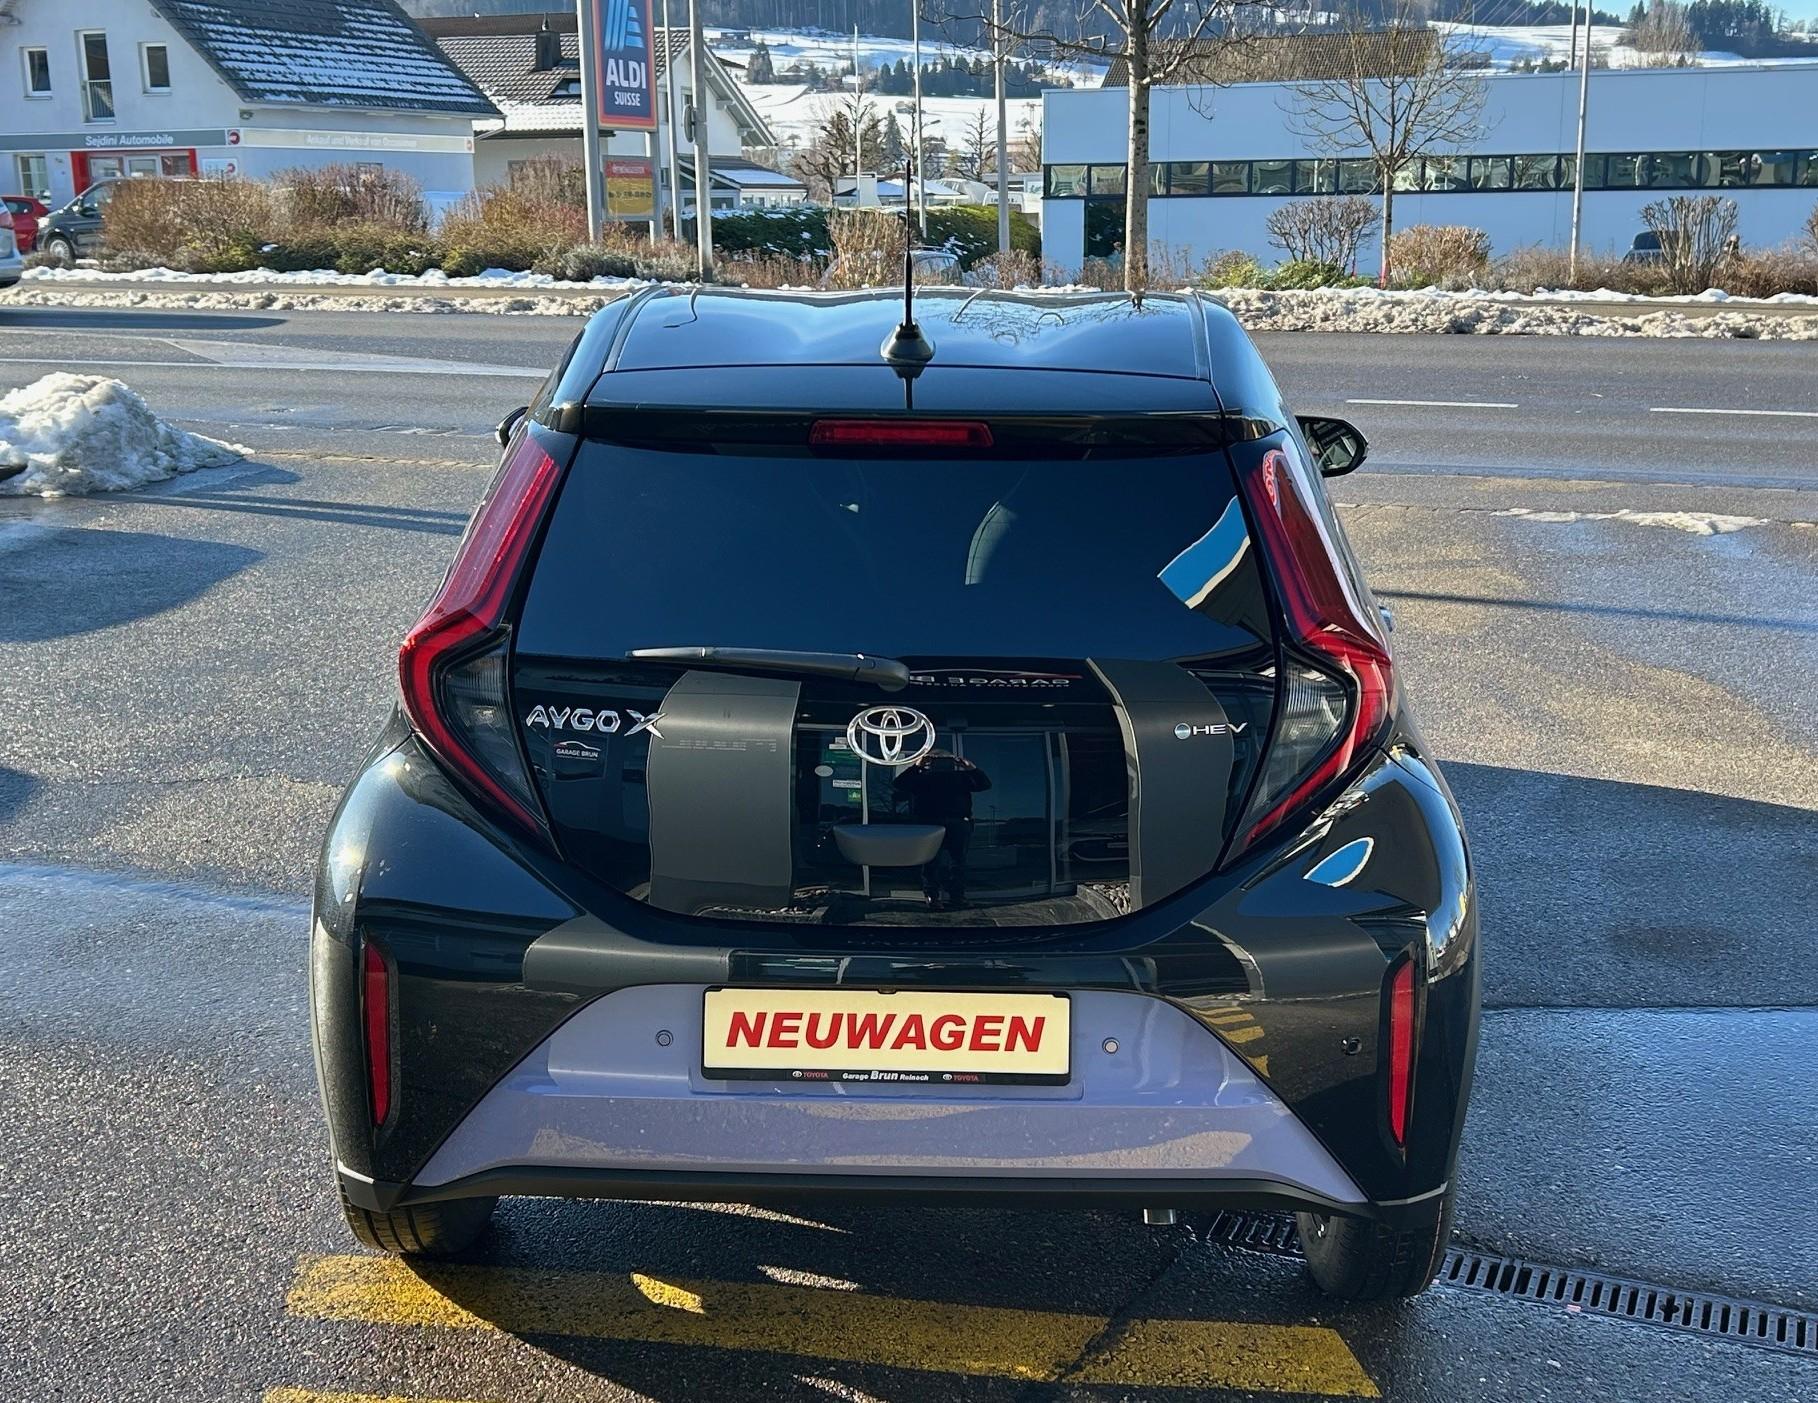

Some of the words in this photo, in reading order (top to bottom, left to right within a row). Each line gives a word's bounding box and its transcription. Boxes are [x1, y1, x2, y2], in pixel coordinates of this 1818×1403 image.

[605, 58, 647, 90] ALDI
[614, 91, 641, 107] SUISSE
[85, 135, 118, 148] Sejdini
[119, 134, 174, 146] Automobile
[526, 704, 621, 733] AYGO
[624, 708, 667, 740] X
[1192, 721, 1249, 736] HEV
[556, 748, 580, 757] GARAGE
[581, 750, 599, 758] BRUN
[725, 1012, 1045, 1052] NEUWAGEN
[803, 1071, 829, 1079] TOYOTA
[842, 1071, 869, 1081] Garage
[870, 1070, 899, 1080] Brun
[953, 1074, 979, 1082] TOYOTA
